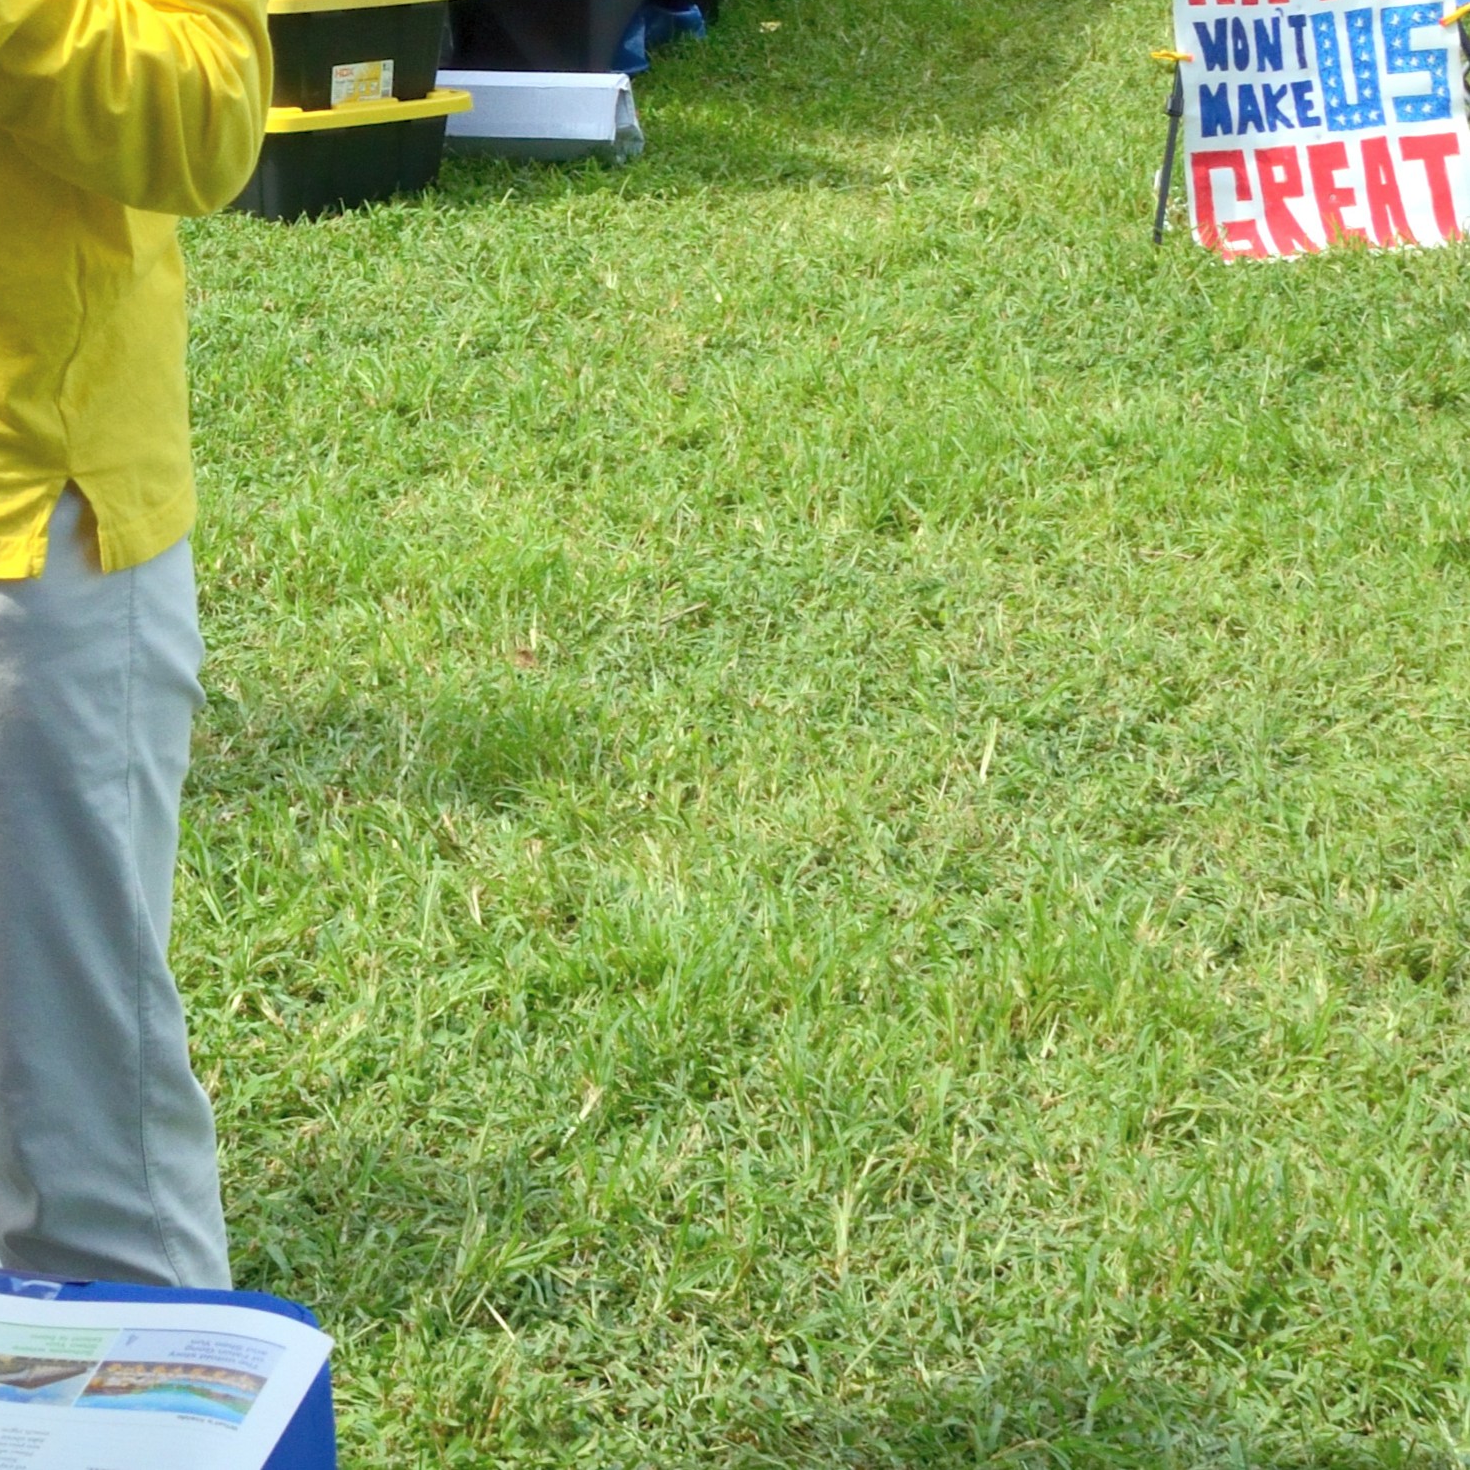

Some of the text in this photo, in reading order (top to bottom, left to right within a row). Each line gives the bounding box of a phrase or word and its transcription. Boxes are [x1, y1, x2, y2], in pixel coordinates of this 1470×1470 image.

[1192, 2, 1452, 132] WON'T US
[1199, 80, 1322, 138] MAKE
[1191, 132, 1462, 261] GREAT
[124, 1334, 140, 1347] 4
